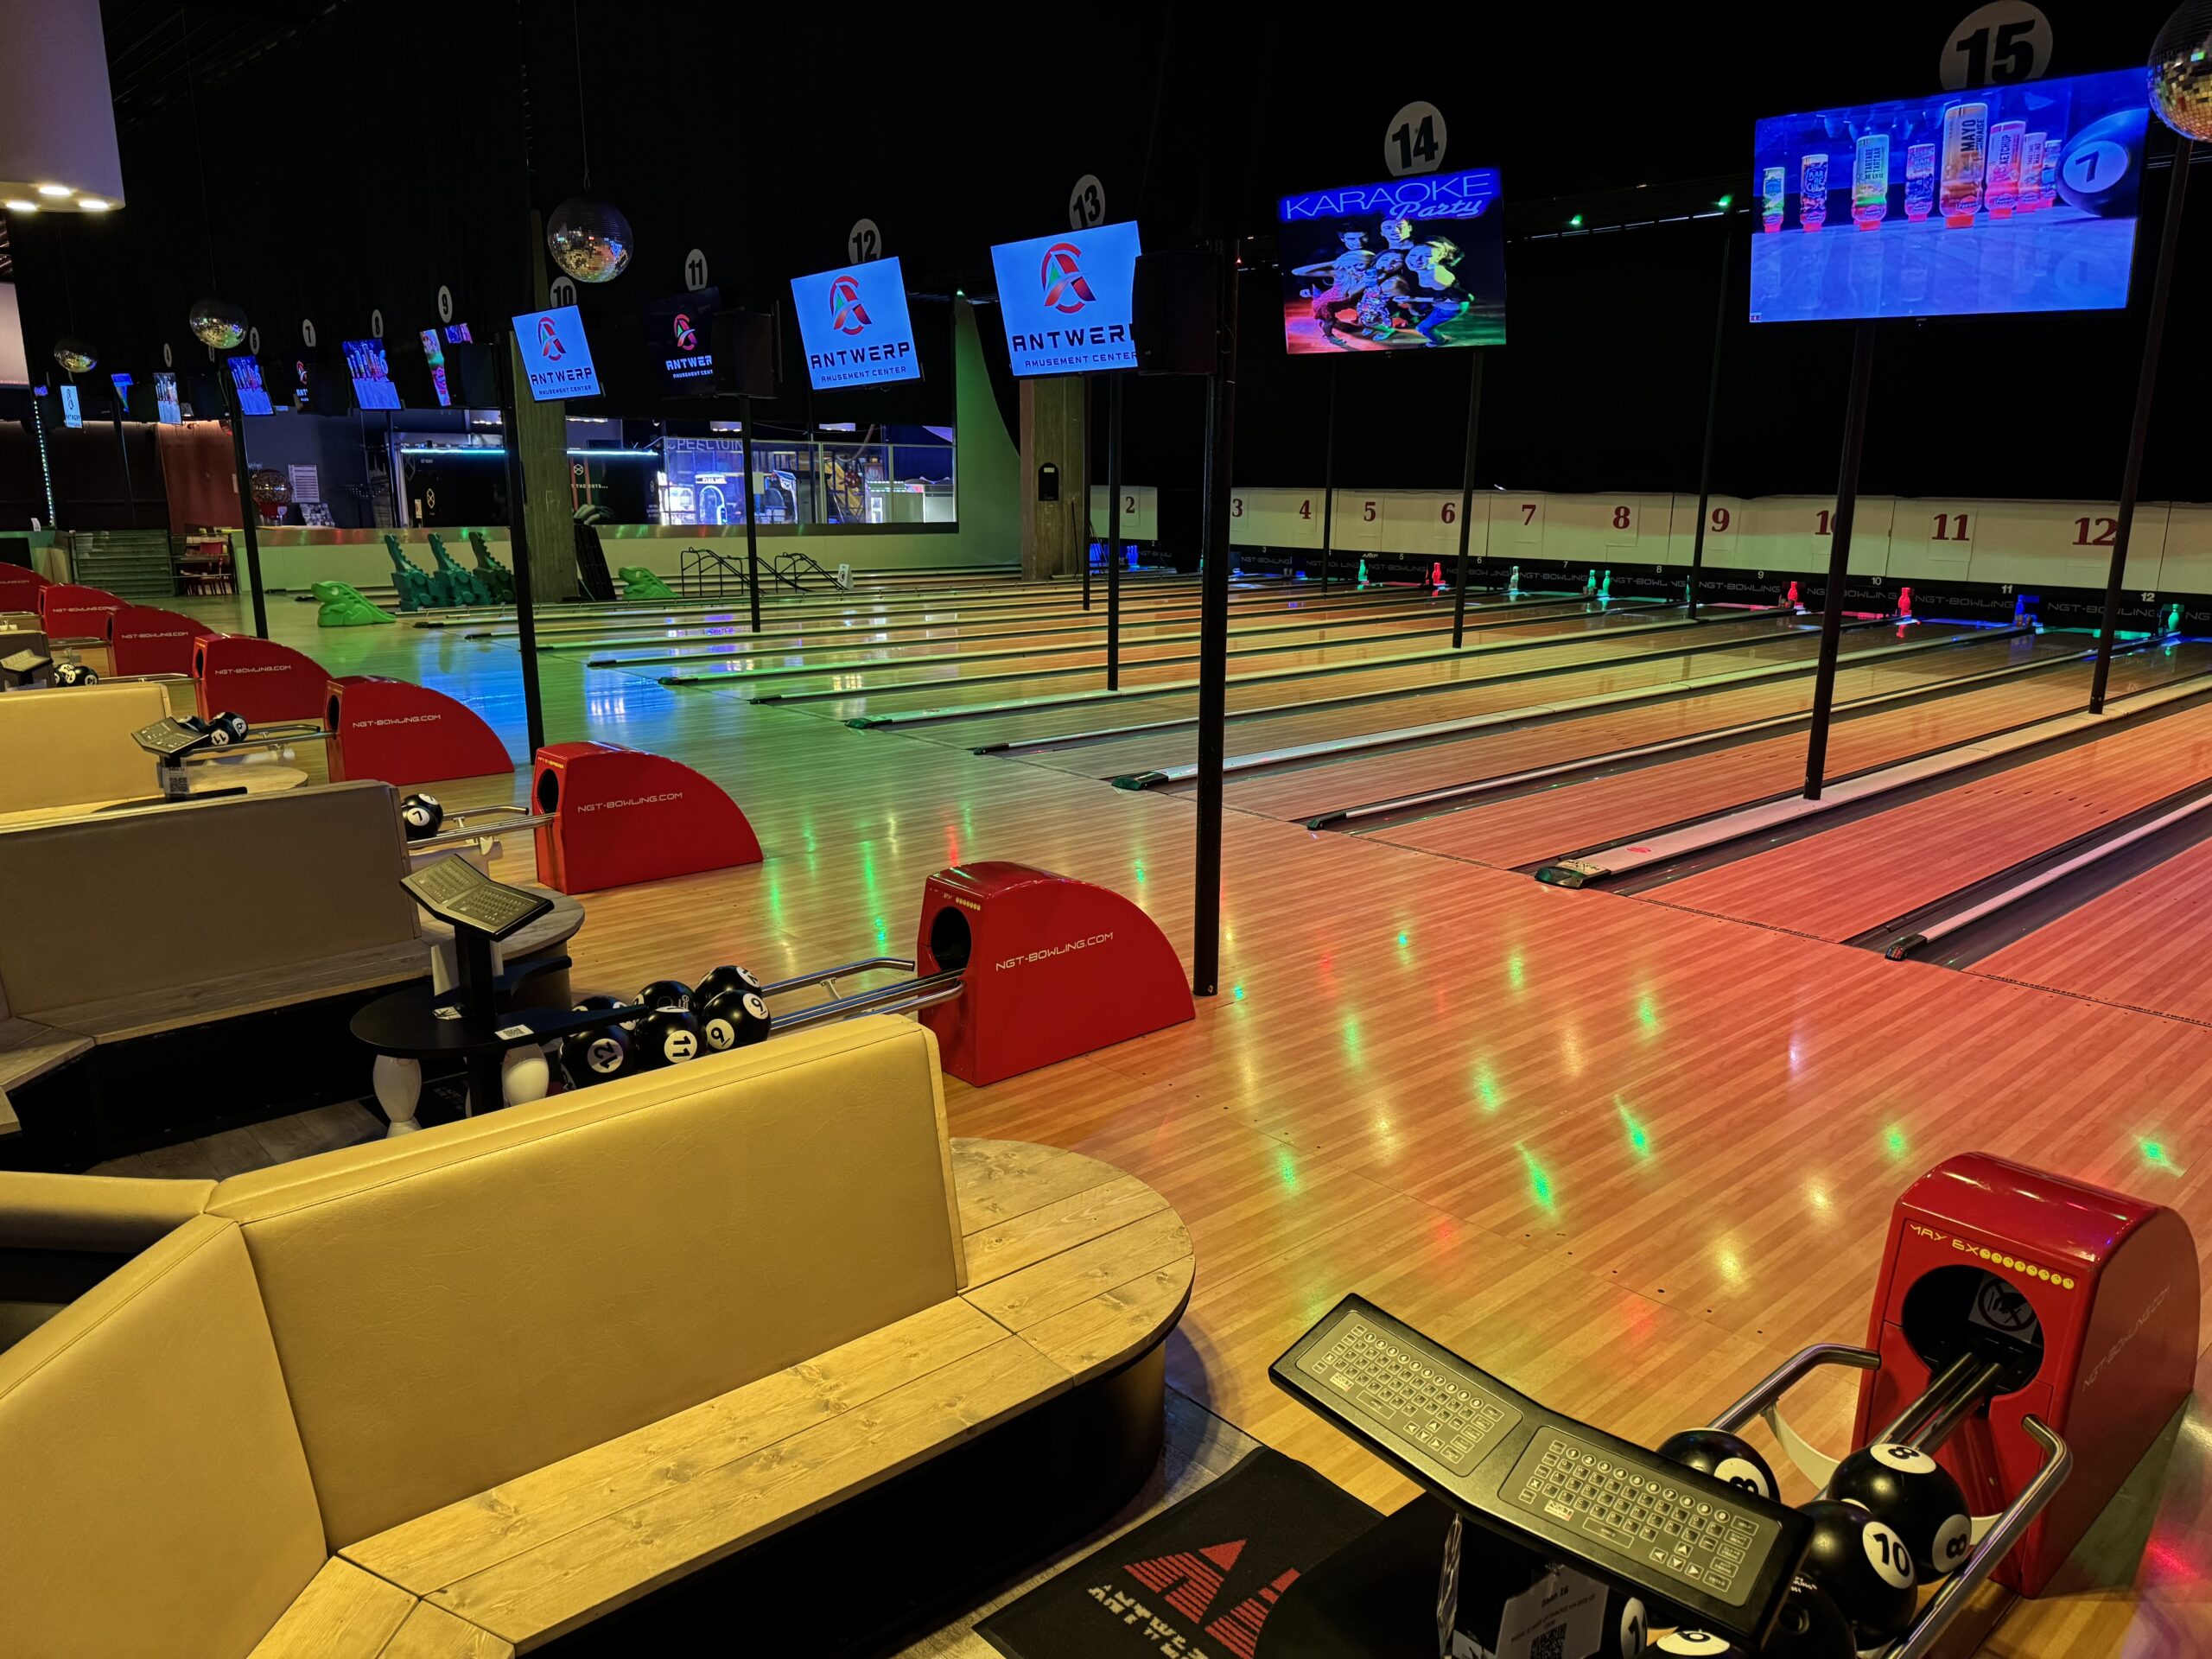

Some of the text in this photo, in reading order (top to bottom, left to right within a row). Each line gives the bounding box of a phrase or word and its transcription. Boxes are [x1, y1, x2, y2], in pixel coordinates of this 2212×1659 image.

[1956, 19, 2036, 86] 15
[1392, 115, 1439, 169] 14
[1961, 119, 1977, 153] MAYO
[1999, 135, 2012, 165] KETCHUP
[2075, 151, 2101, 181] 7
[1286, 173, 1492, 219] KARAOKE
[1073, 184, 1101, 229] 13
[1389, 200, 1483, 219] Party
[852, 230, 877, 263] 12
[688, 258, 704, 286] 11
[442, 294, 448, 315] 9
[553, 285, 574, 306] 10
[305, 326, 311, 340] 7
[1012, 323, 1134, 353] ANTWER
[810, 341, 910, 369] ANTWERP
[1025, 356, 1089, 367] AMUSEMENT
[531, 367, 593, 386] ANTWERP
[821, 366, 906, 382] AMUSEMENT CENTER
[539, 386, 569, 395] AMUSEMENT
[1126, 497, 1135, 513] 2
[1232, 499, 1243, 518] 3
[1300, 500, 1312, 519] 4
[1363, 502, 1376, 522] 5
[1441, 503, 1456, 524] 6
[1522, 505, 1536, 525] 7
[1612, 506, 1630, 529] 8
[1712, 508, 1730, 531] 9
[1931, 513, 1970, 541] 11
[2073, 517, 2119, 546] 12
[1369, 563, 1426, 572] NGT-BOWLING
[1519, 572, 1589, 582] NGT-BOWLING
[1698, 581, 1781, 594] NGT-BOWLING
[1872, 577, 1882, 586] 10
[2001, 585, 2013, 594] 11
[1914, 594, 2015, 608] NGT-BOWLING
[2140, 592, 2156, 602] 12
[121, 631, 189, 639] NGT-BOWLING.COM
[214, 664, 291, 675] NGT-BOWLING.COM
[352, 714, 442, 728] NGT-BOWLING.COM
[577, 792, 683, 813] NGT-BOWLING.COM
[412, 810, 423, 821] 7
[995, 931, 1114, 971] NGT-BOWLING.COM
[593, 1041, 619, 1070] 12
[673, 1035, 691, 1058] 11
[1951, 1238, 1980, 1255] 6X
[1888, 1446, 1920, 1459] 8
[1872, 1532, 1910, 1577] 10
[1946, 1533, 1967, 1559] 8
